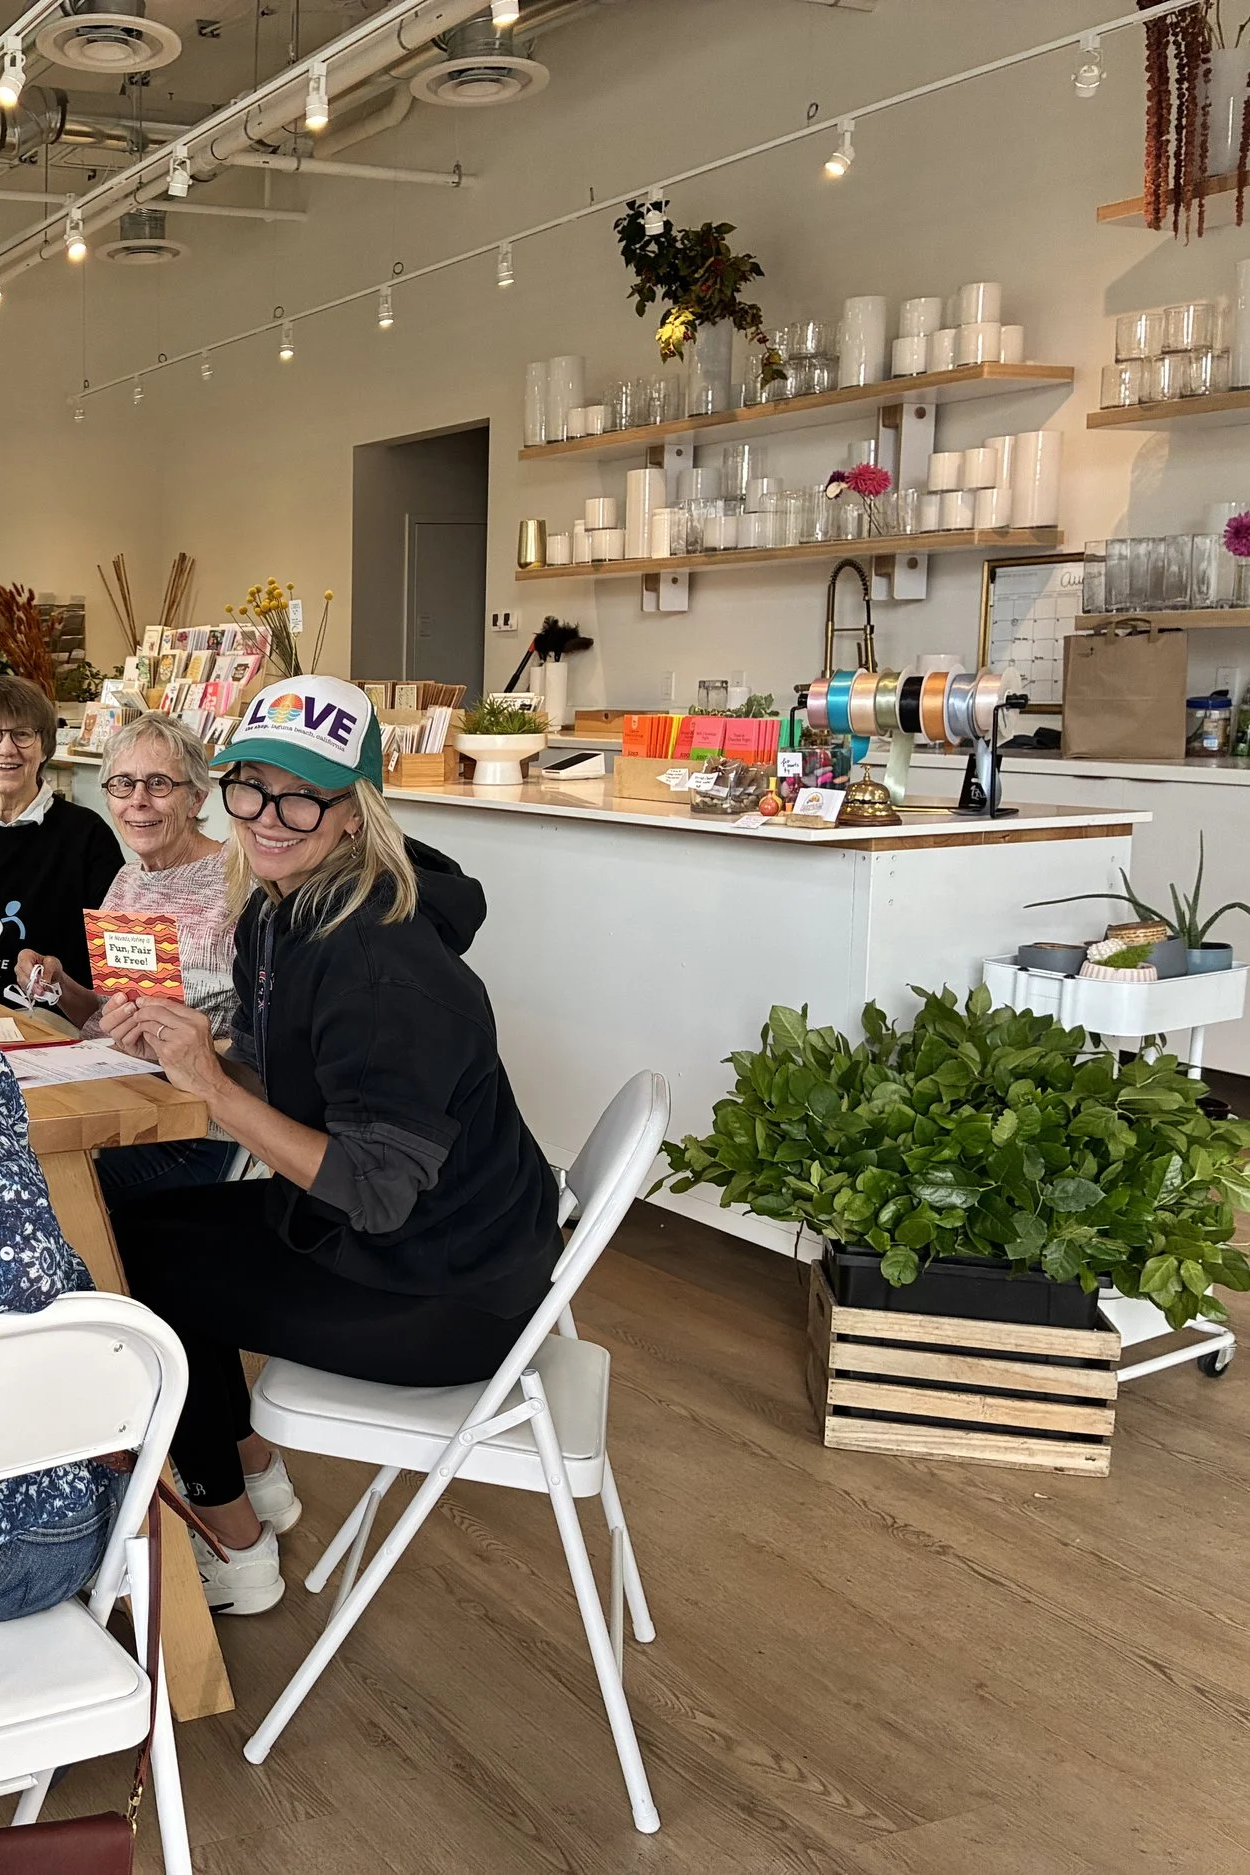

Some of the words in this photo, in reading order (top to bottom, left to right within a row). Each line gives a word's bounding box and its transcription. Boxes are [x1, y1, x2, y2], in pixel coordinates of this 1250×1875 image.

[248, 694, 357, 746] LOVE
[271, 724, 293, 732] laguna
[315, 734, 346, 752] california
[109, 943, 130, 954] Fun,
[130, 945, 152, 955] Fair
[114, 955, 121, 964] &
[123, 955, 148, 966] Free!
